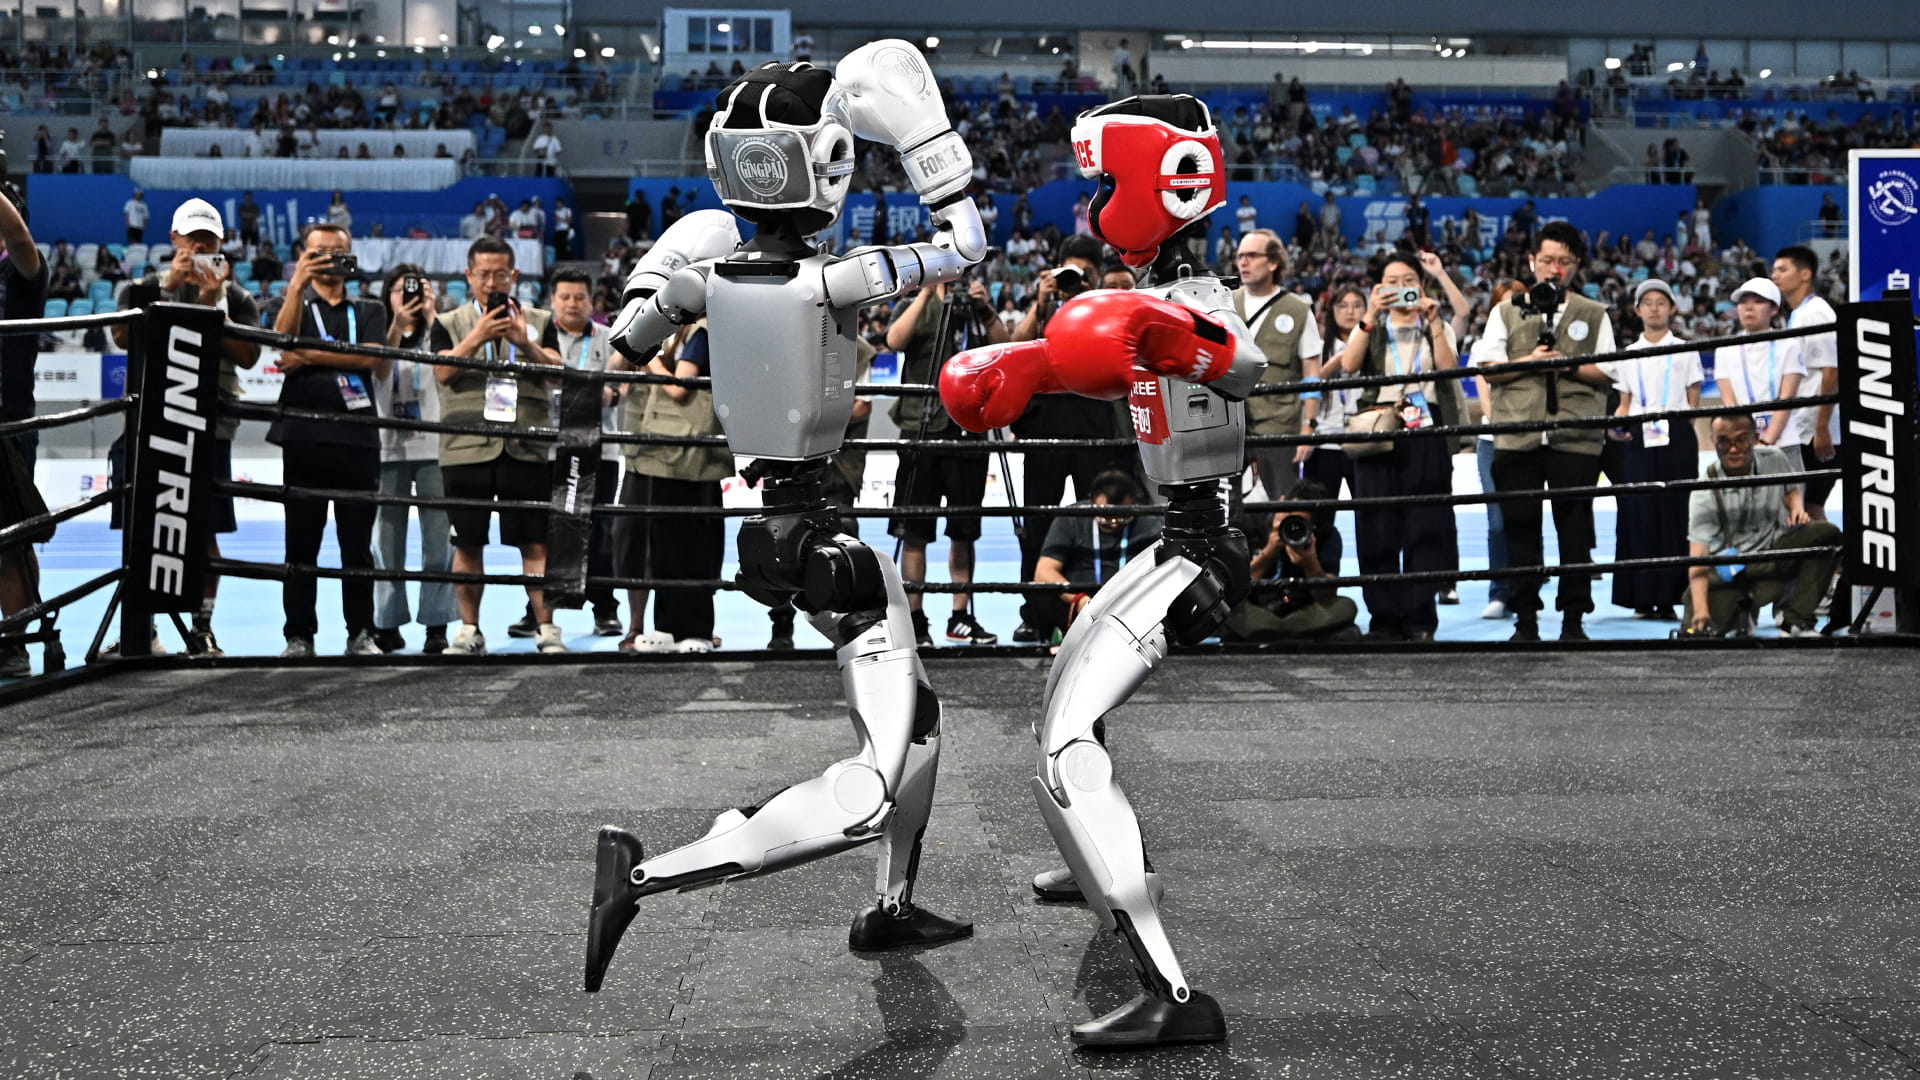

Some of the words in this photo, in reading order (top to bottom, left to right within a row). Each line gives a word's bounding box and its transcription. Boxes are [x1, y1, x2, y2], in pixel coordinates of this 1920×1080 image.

[739, 158, 784, 179] GINGPAI
[918, 145, 962, 178] FORCE
[852, 205, 933, 240] 首钢
[1131, 381, 1157, 397] REE
[149, 325, 207, 596] UNITREE
[1850, 318, 1905, 571] UNITREE
